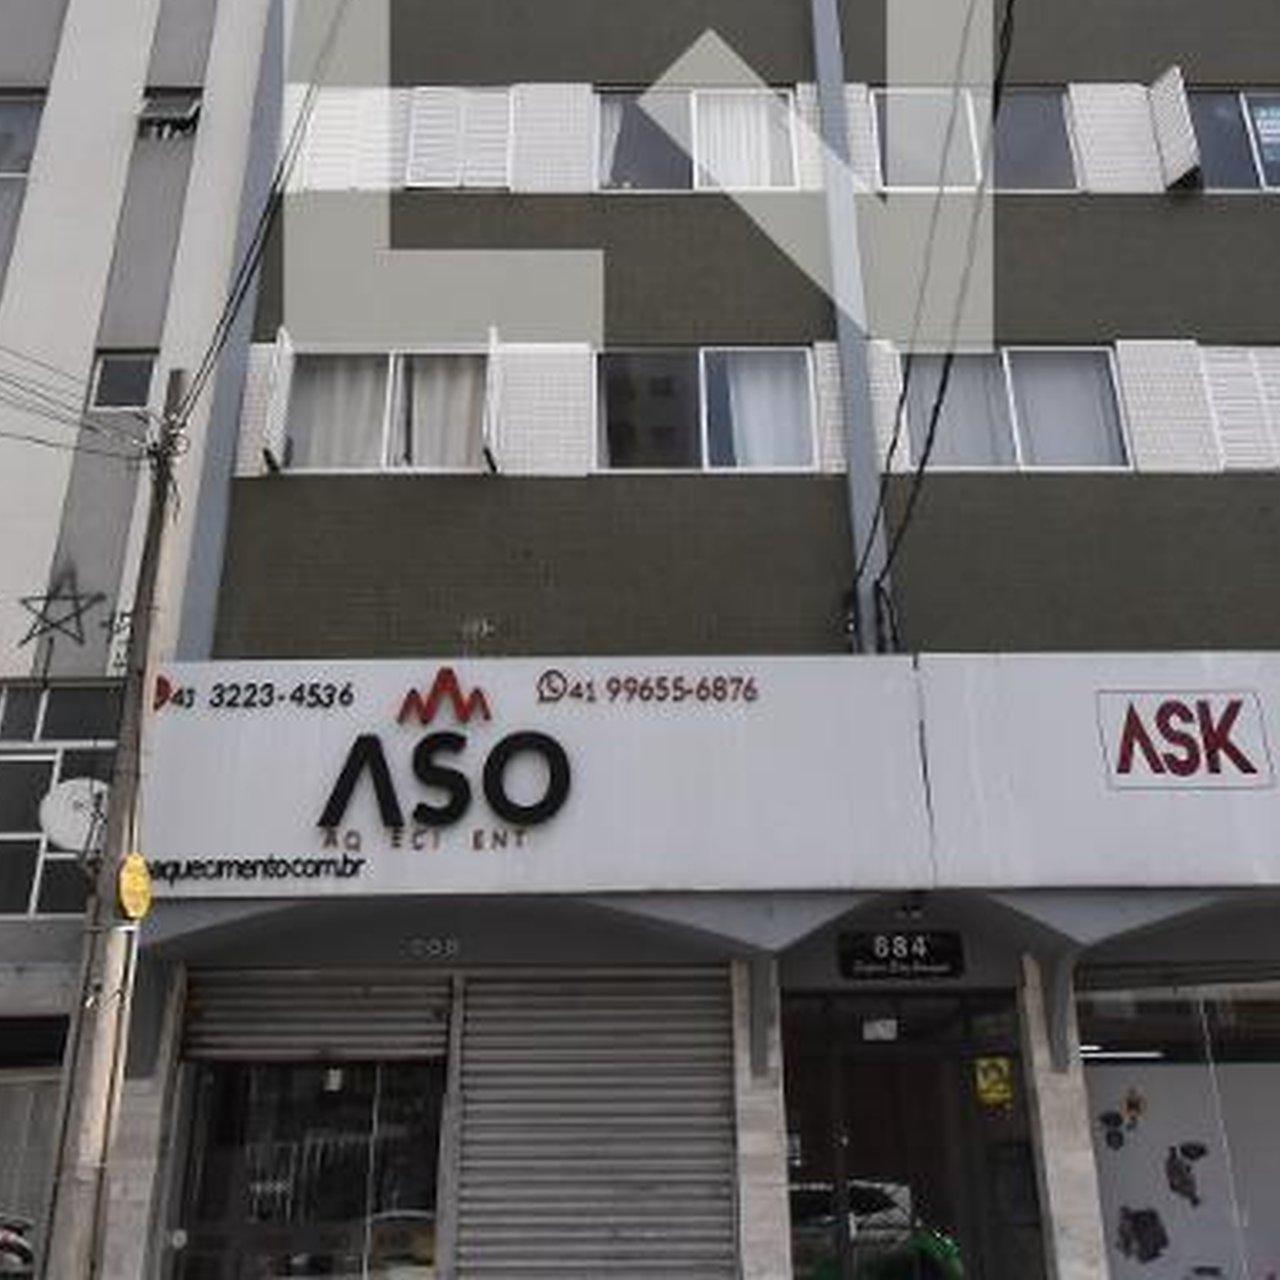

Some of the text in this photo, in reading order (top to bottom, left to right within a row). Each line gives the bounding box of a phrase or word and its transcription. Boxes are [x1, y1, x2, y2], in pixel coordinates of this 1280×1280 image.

[209, 682, 355, 709] 3223-4536
[606, 676, 759, 702] 99655-6876
[1117, 699, 1257, 777] ASK
[317, 731, 571, 827] ASO
